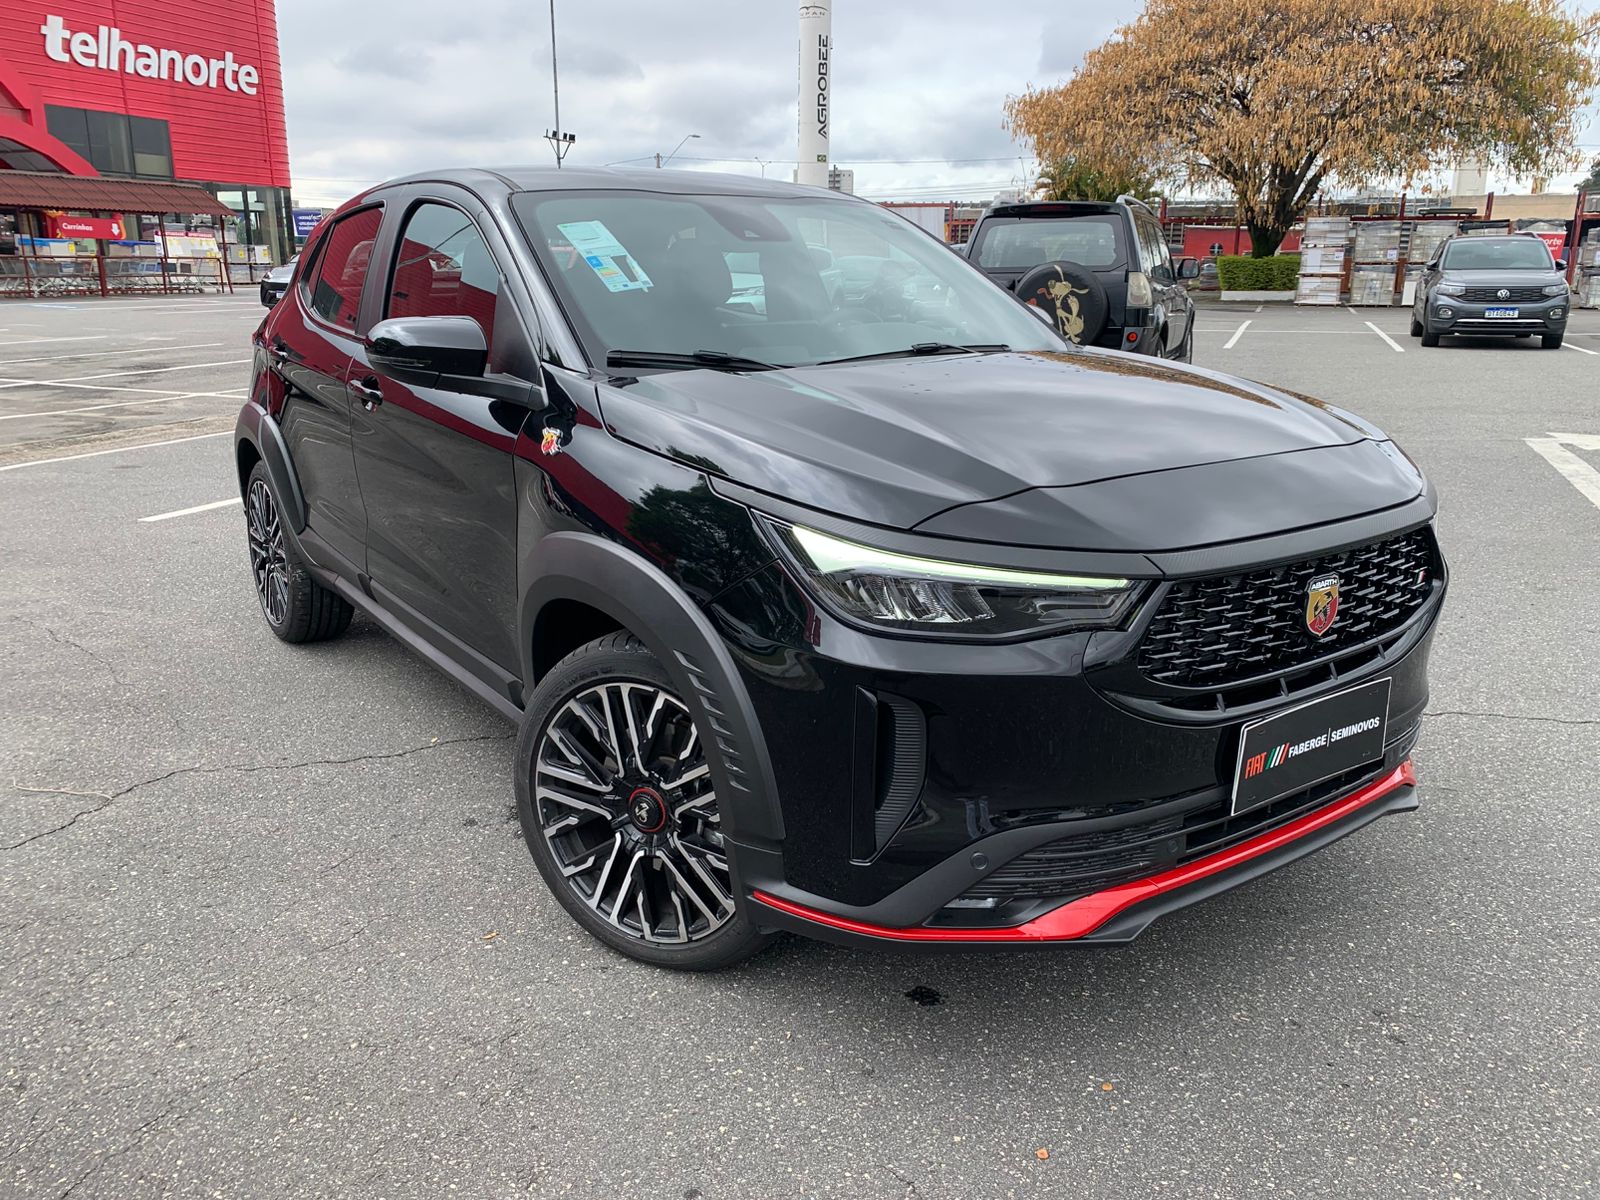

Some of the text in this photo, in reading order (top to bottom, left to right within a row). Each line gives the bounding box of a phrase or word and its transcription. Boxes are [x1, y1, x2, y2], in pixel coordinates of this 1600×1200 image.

[40, 14, 259, 96] telhanorte
[817, 34, 829, 139] AGROBEE
[62, 222, 93, 231] Carrinhos
[1311, 579, 1338, 590] ABARTH
[1244, 717, 1380, 779] FIAT FABERGE SEMINOVOS
